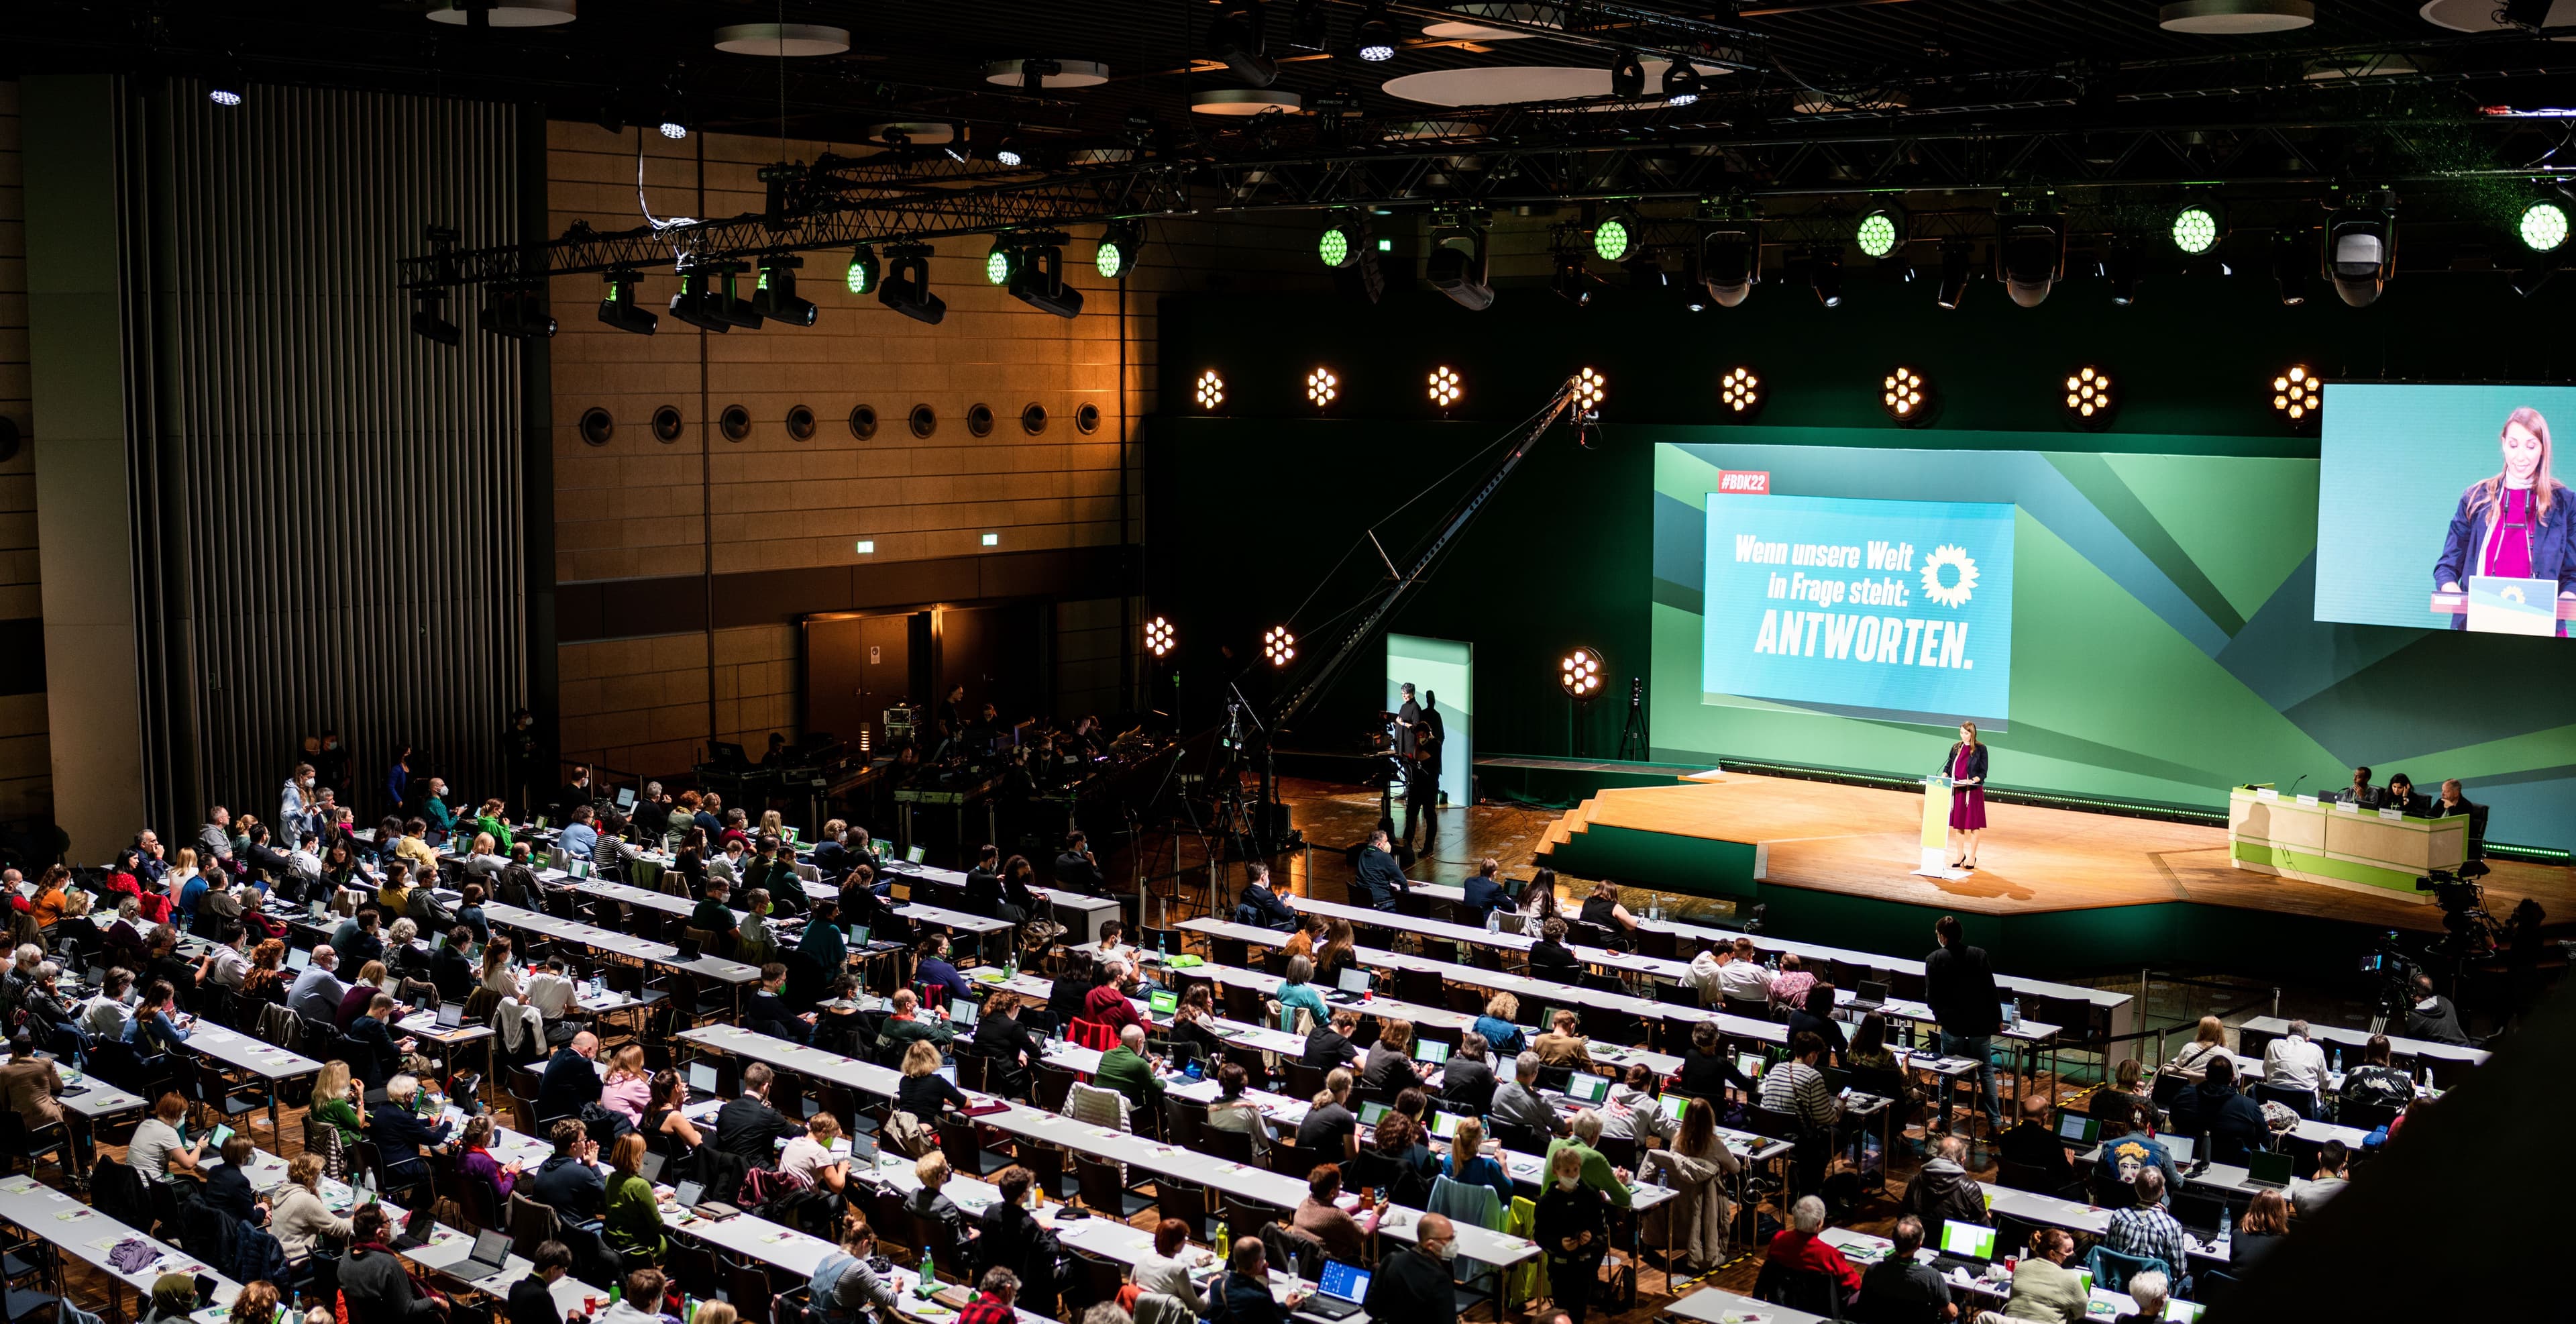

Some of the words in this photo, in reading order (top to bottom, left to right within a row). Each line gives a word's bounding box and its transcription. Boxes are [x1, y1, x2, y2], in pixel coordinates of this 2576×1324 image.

[1721, 474, 1766, 491] #BDK22
[1735, 534, 1788, 564] Wenn
[1791, 544, 1861, 568] unsere
[1867, 540, 1915, 572] Welt
[1767, 571, 1787, 600] in
[1790, 572, 1845, 608] Frage
[1849, 577, 1910, 607] steht:
[1753, 608, 1974, 670] ANTWORTEN.
[289, 855, 304, 866] OVE
